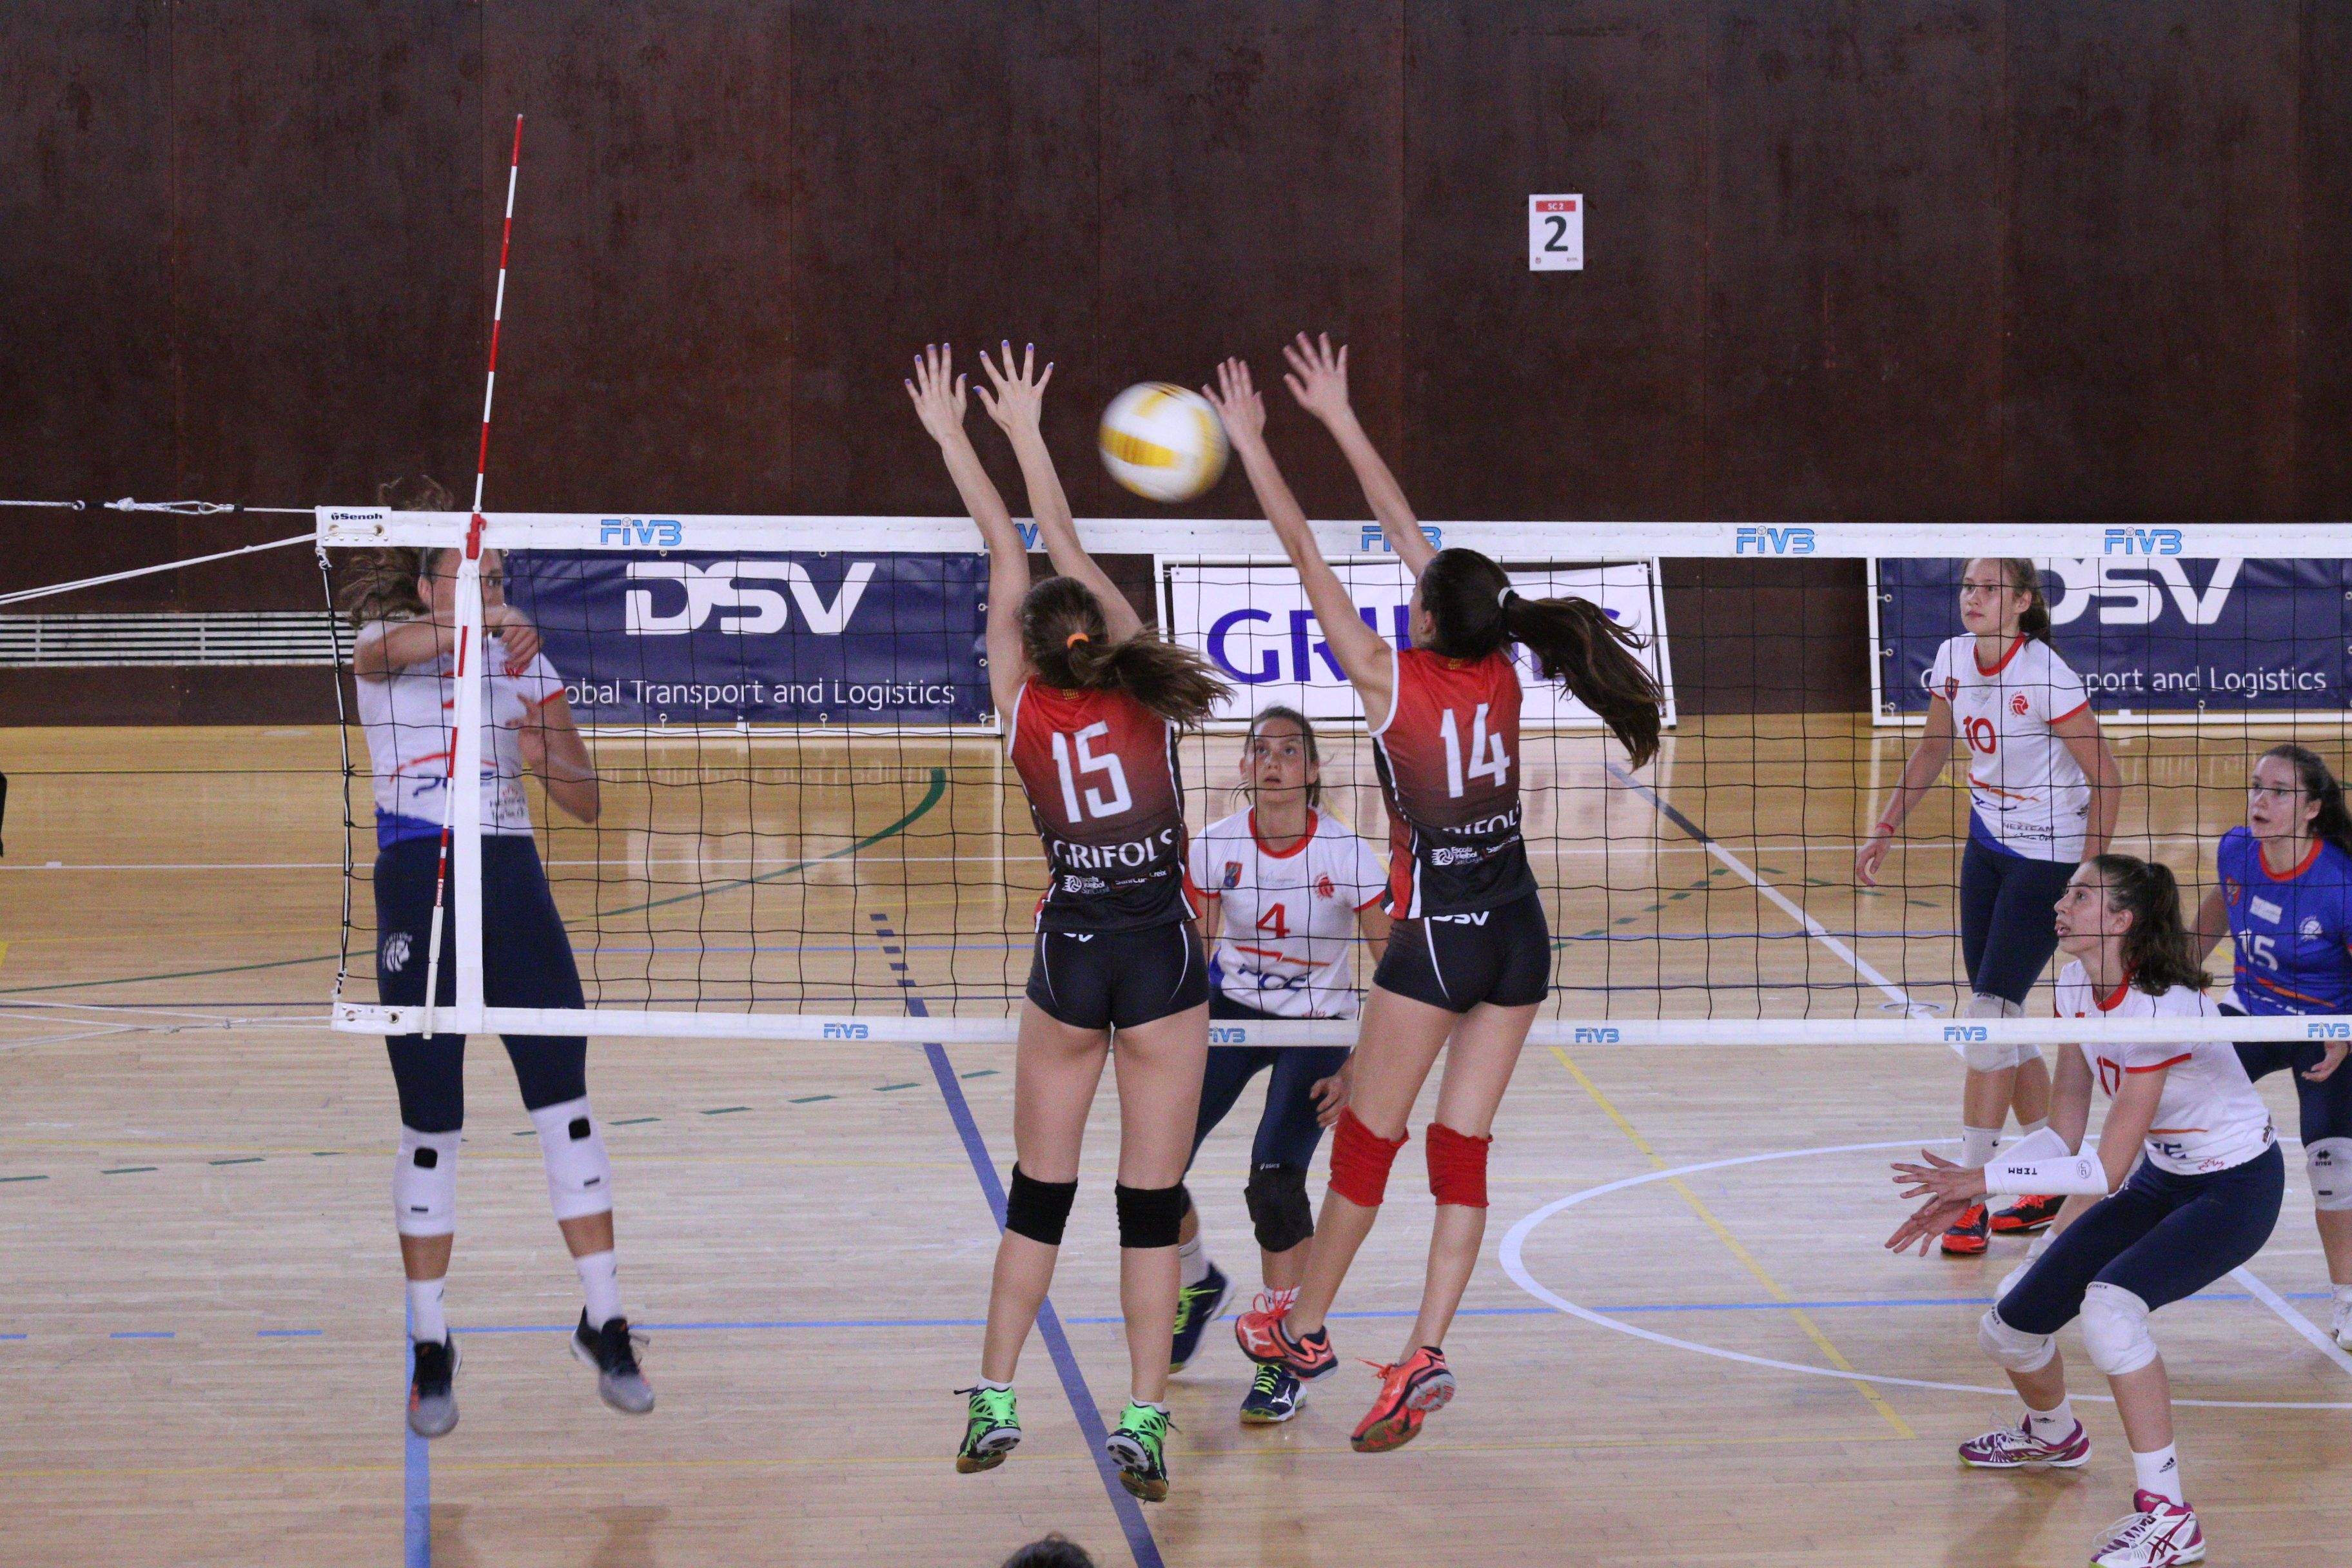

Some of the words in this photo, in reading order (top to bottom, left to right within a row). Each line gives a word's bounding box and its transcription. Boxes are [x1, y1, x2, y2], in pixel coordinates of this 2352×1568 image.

[1545, 215, 1569, 251] 2
[625, 561, 876, 635] DSV
[565, 678, 620, 705] obal
[630, 680, 764, 710] Transport
[774, 678, 823, 704] and
[834, 679, 955, 711] Logistics
[2153, 667, 2200, 691] and
[2210, 667, 2327, 698] Logistics
[1440, 702, 1511, 798] 14
[1963, 715, 1997, 754] 10
[1052, 720, 1133, 823] 15
[1257, 903, 1291, 939] 4
[2238, 928, 2278, 972] 15
[2008, 1167, 2038, 1175] TEAM
